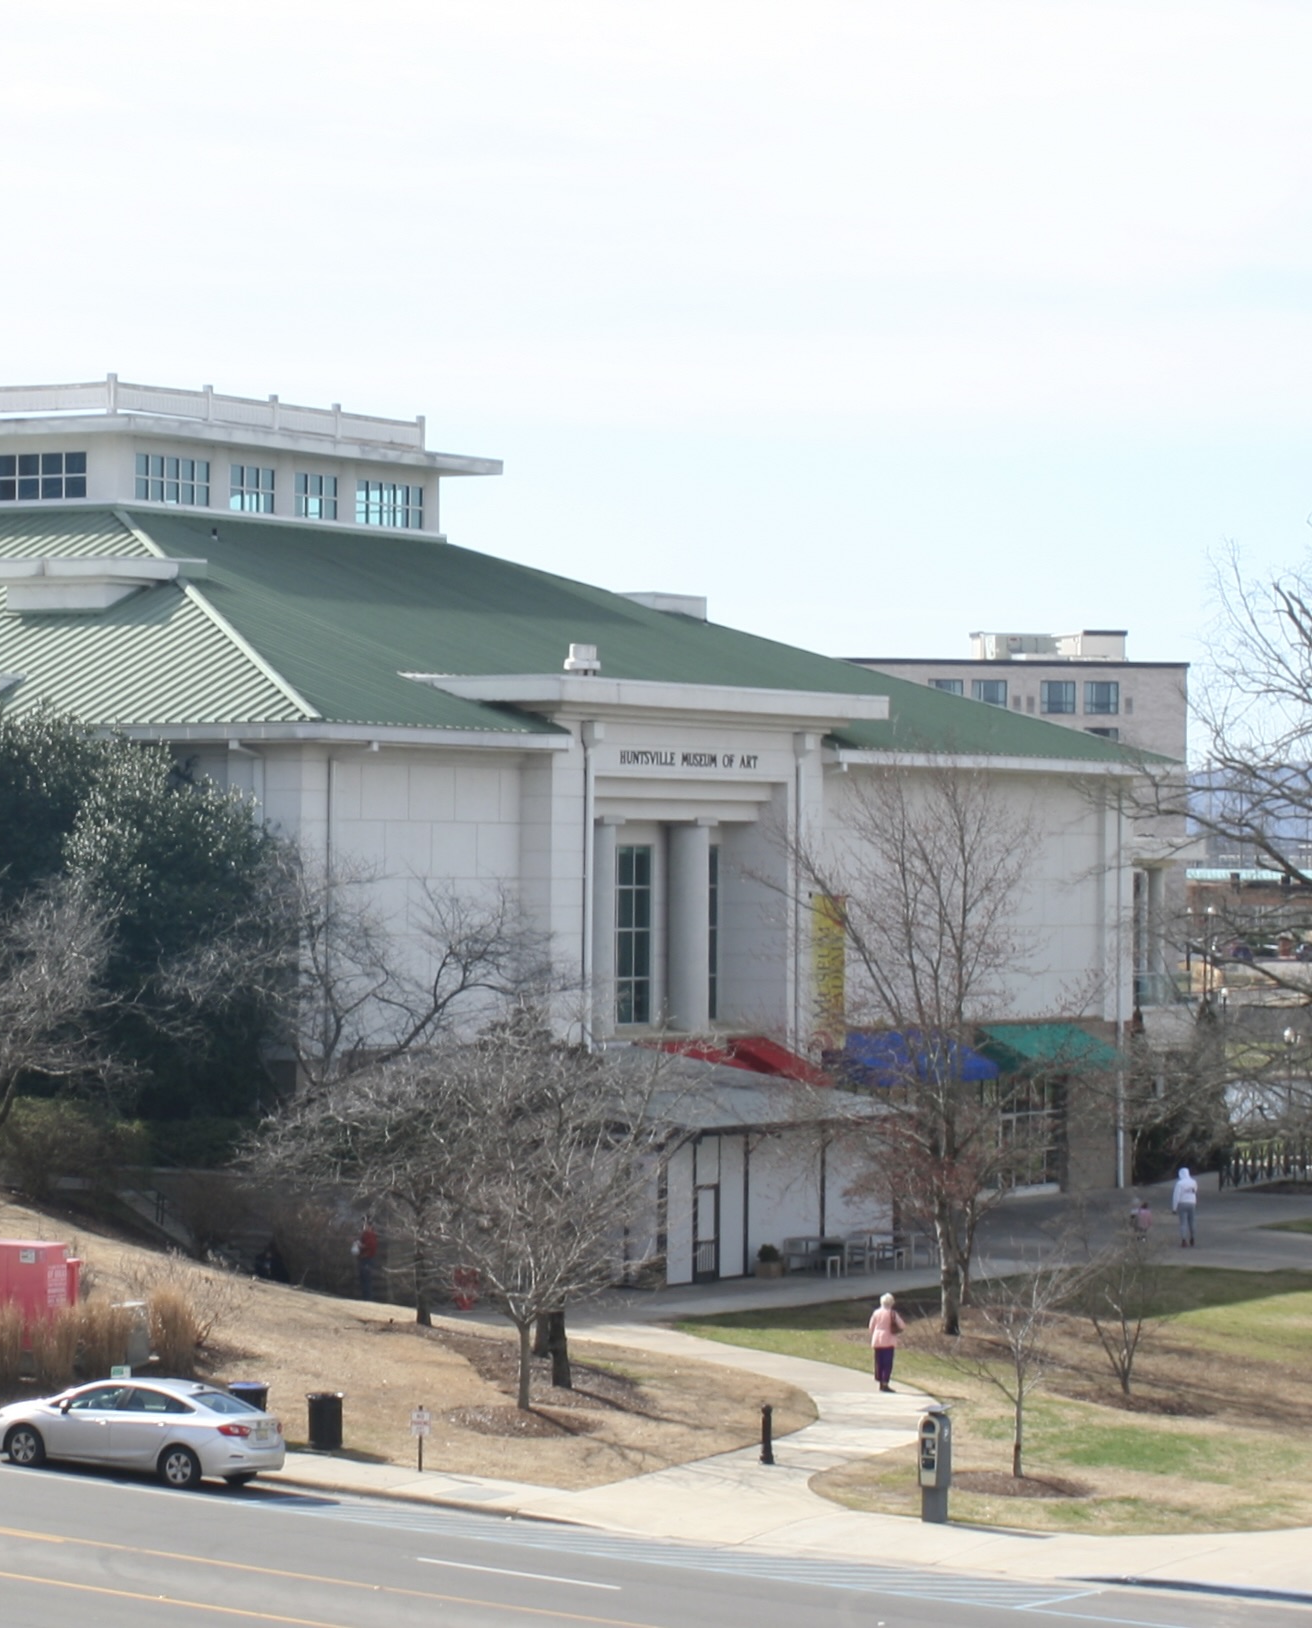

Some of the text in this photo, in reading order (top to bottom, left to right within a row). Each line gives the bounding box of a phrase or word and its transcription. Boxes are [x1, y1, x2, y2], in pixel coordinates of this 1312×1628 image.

[620, 750, 758, 769] HUNTSVILLE MUSEUM OF ART
